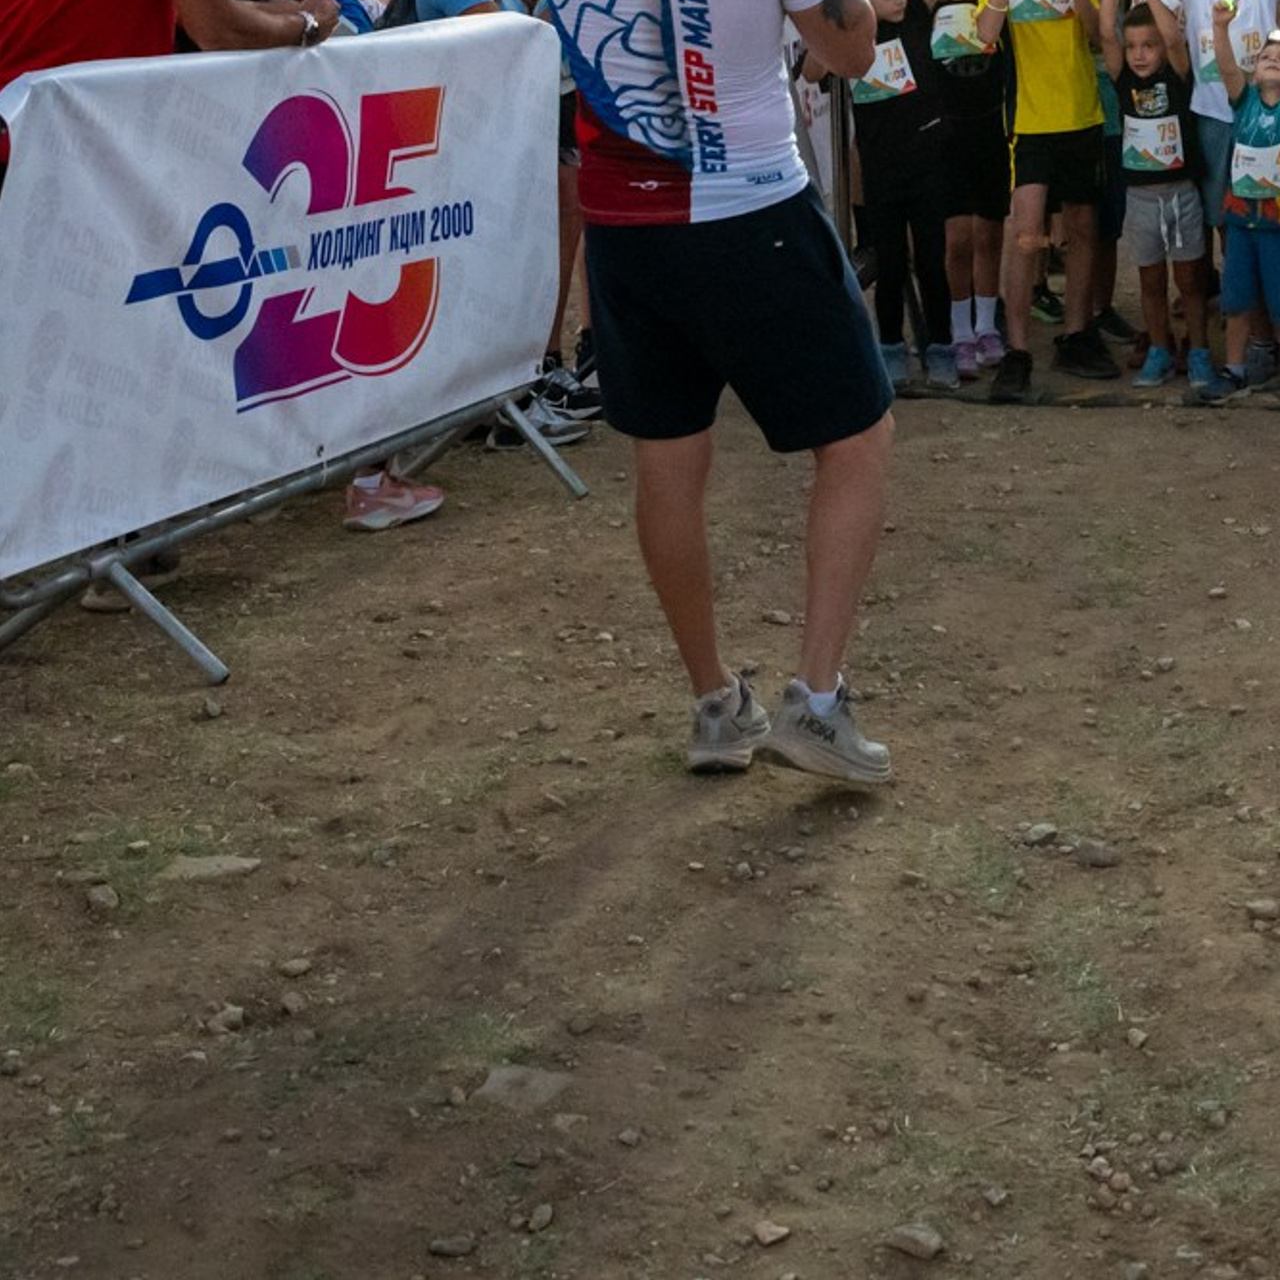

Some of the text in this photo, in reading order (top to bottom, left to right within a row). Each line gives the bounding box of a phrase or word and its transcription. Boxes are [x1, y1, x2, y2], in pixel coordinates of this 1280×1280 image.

[1241, 31, 1262, 53] 78
[883, 45, 904, 67] 74
[684, 49, 718, 114] STEP
[883, 67, 906, 82] KIDS
[1157, 121, 1178, 142] 79
[1153, 144, 1177, 157] KIDS
[307, 200, 475, 271] ХОЛДИНГ КЦМ 2000
[797, 713, 836, 745] HOKA
